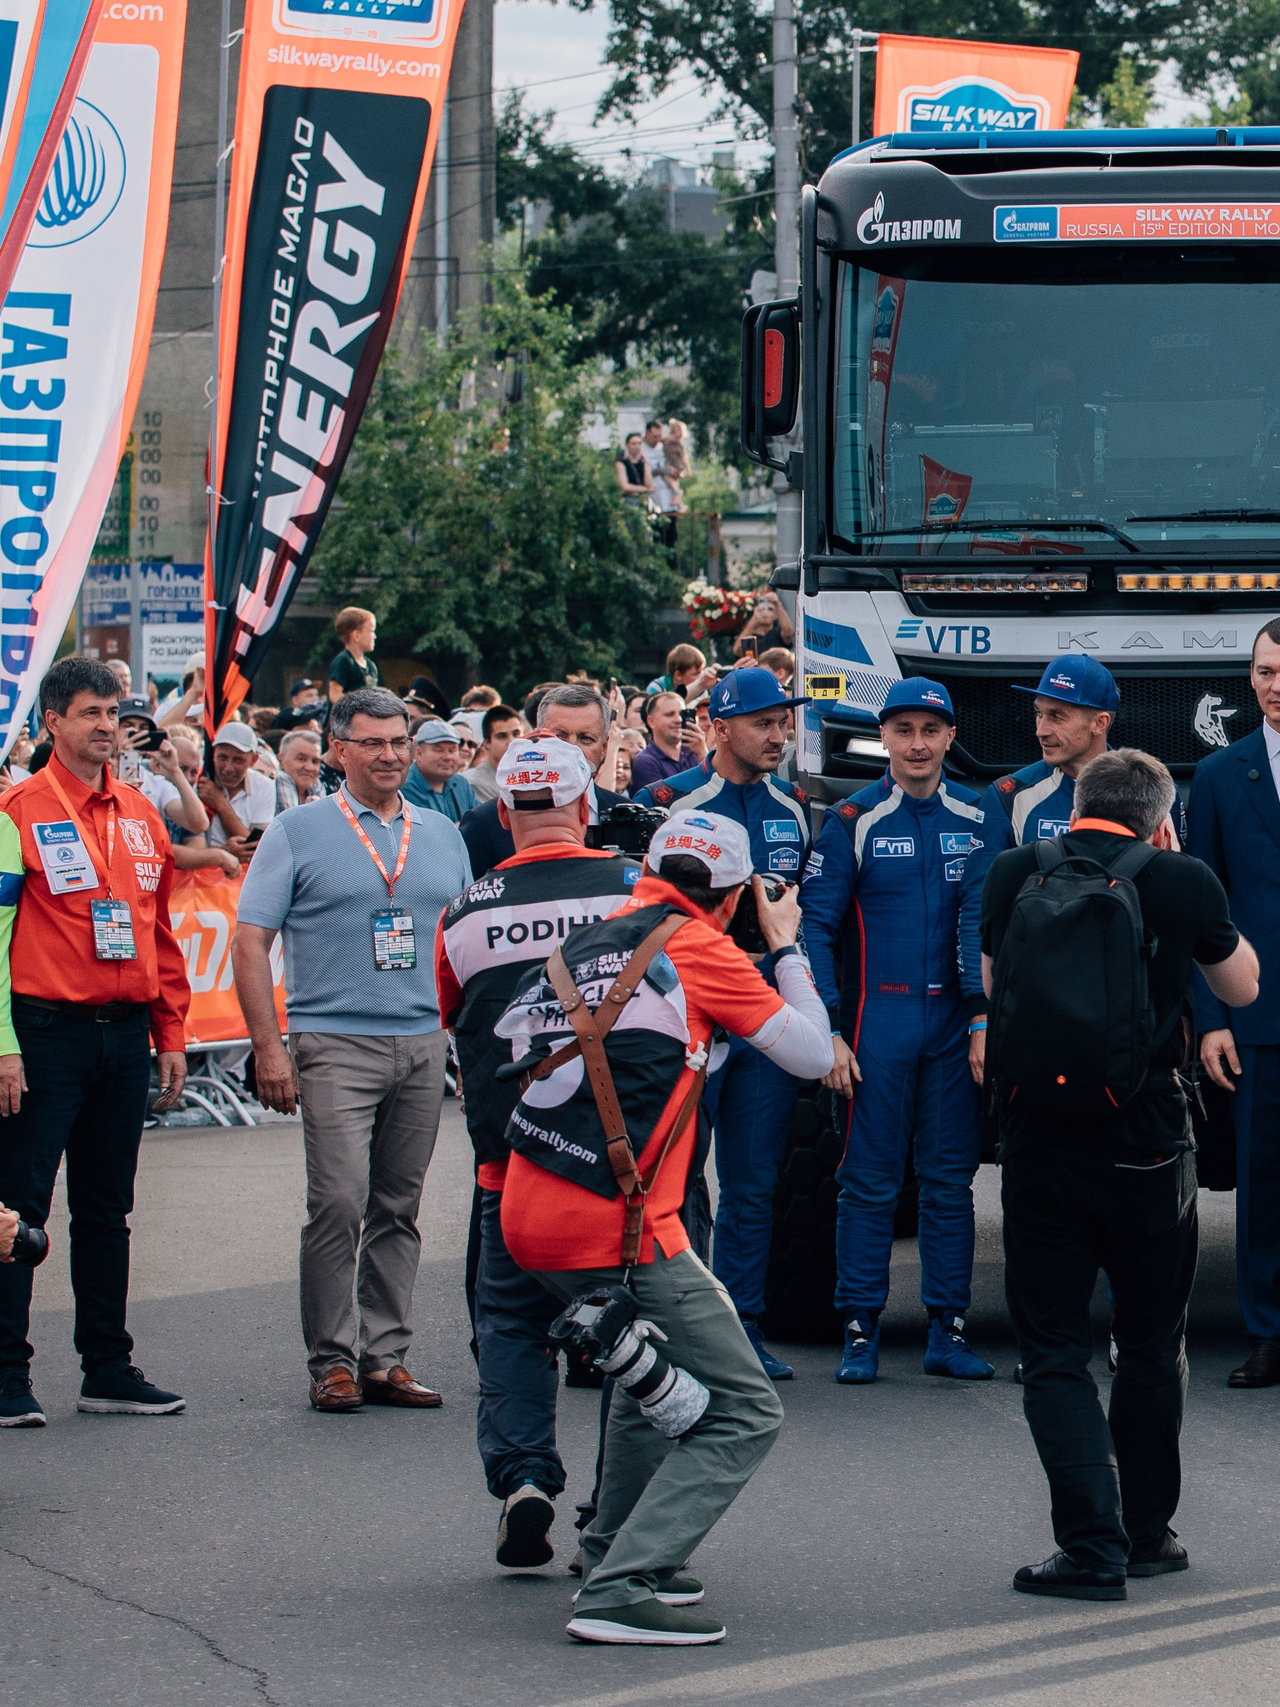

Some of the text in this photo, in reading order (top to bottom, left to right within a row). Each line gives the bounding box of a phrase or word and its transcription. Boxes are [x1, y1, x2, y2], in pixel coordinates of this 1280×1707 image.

[322, 1, 396, 16] RALLY
[267, 45, 441, 78] silkwayrally.com
[912, 103, 1035, 127] SILK WAY
[277, 116, 315, 264] МАСЛО
[1135, 208, 1273, 221] SILK WAY RALLY
[884, 218, 962, 243] ГАЗПРОМ
[1017, 222, 1050, 232] GAZPROM
[1065, 223, 1125, 237] RUSSIA
[1141, 221, 1164, 235] 15th
[1168, 222, 1233, 236] EDITION
[925, 625, 991, 654] VTB
[1050, 678, 1076, 689] KAMAZ
[921, 694, 945, 705] KAMAZ
[505, 770, 561, 786] 丝绸之路
[1052, 825, 1070, 835] VT
[664, 835, 723, 861] 丝绸之路
[887, 842, 912, 854] VTB
[469, 876, 506, 894] SILK
[469, 887, 506, 903] WAY
